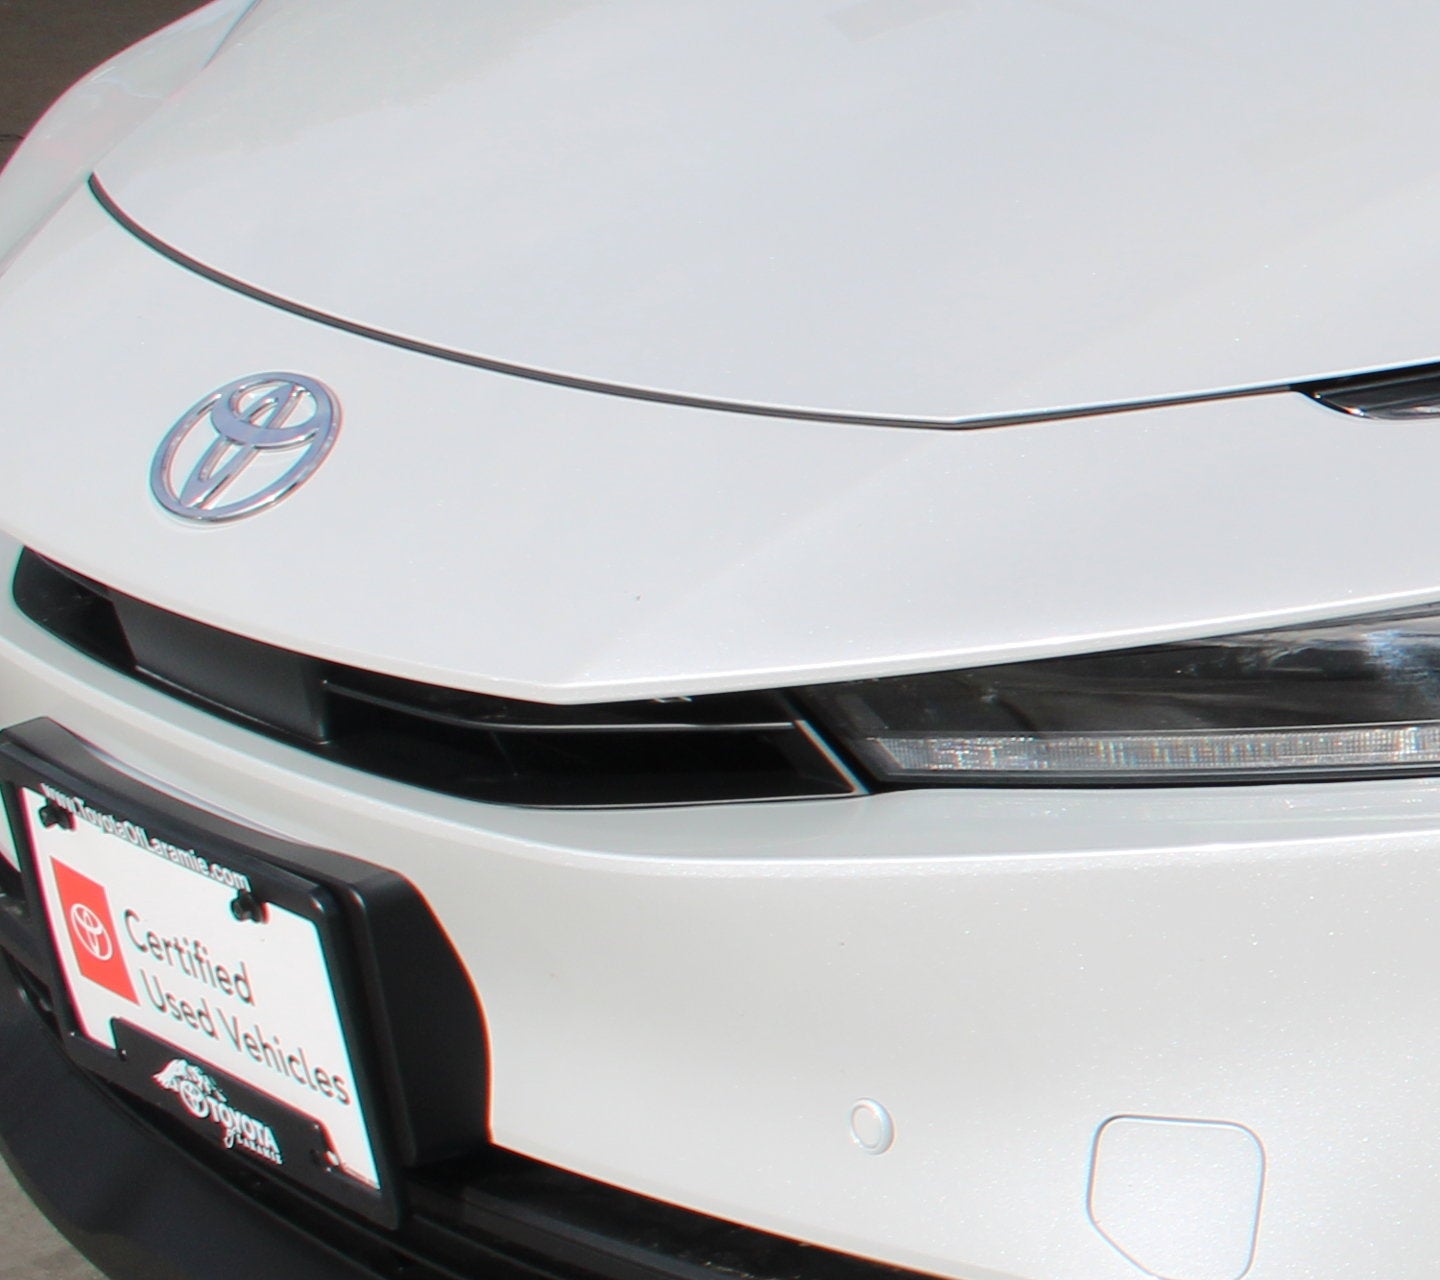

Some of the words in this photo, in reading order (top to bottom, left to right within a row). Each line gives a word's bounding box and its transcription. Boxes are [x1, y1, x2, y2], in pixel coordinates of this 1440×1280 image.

[124, 908, 255, 1007] Certified
[140, 968, 220, 1041] Used
[216, 1006, 351, 1105] Vehicles
[206, 1094, 281, 1154] TOYOTA
